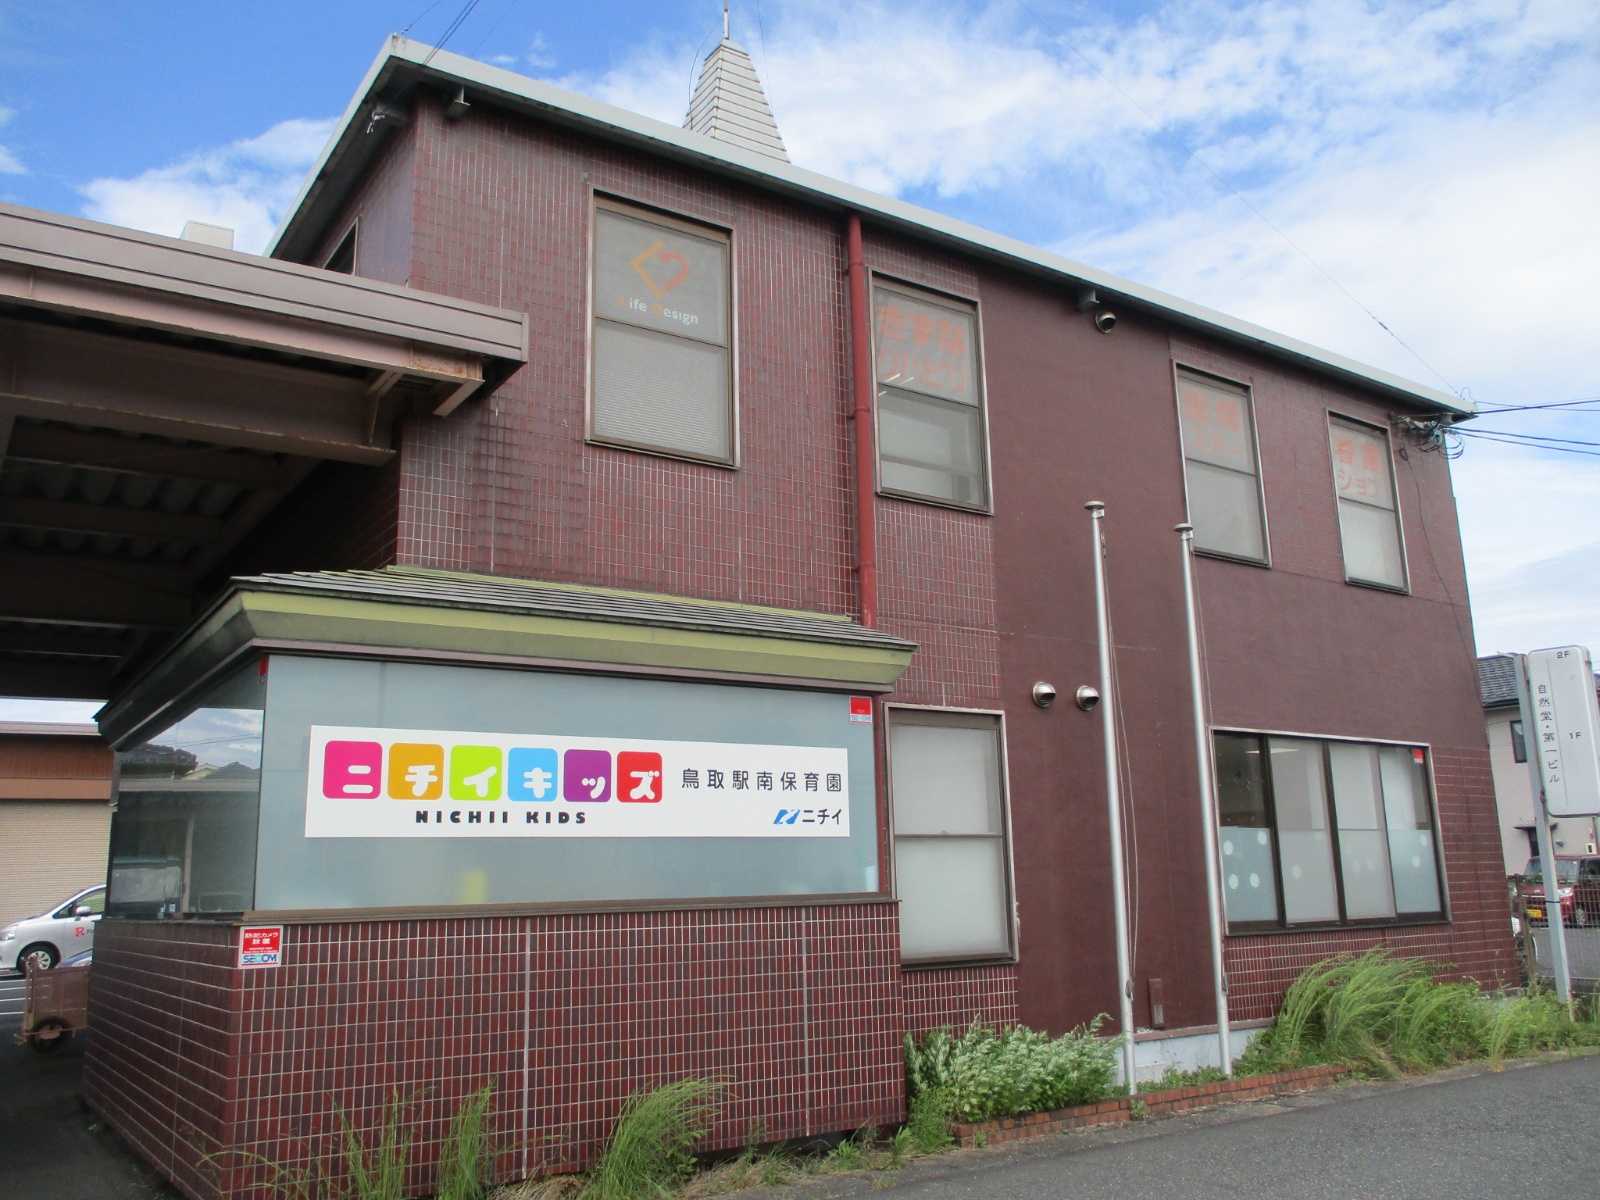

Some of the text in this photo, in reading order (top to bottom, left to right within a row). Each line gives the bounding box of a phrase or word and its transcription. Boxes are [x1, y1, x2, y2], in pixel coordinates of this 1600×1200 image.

[1569, 732, 1582, 740] 1F
[340, 762, 662, 801] ニチイキッズ
[681, 767, 843, 793] 鳥取駅南保育園
[415, 810, 587, 825] NICHII KIDS
[801, 808, 843, 826] ニチイ
